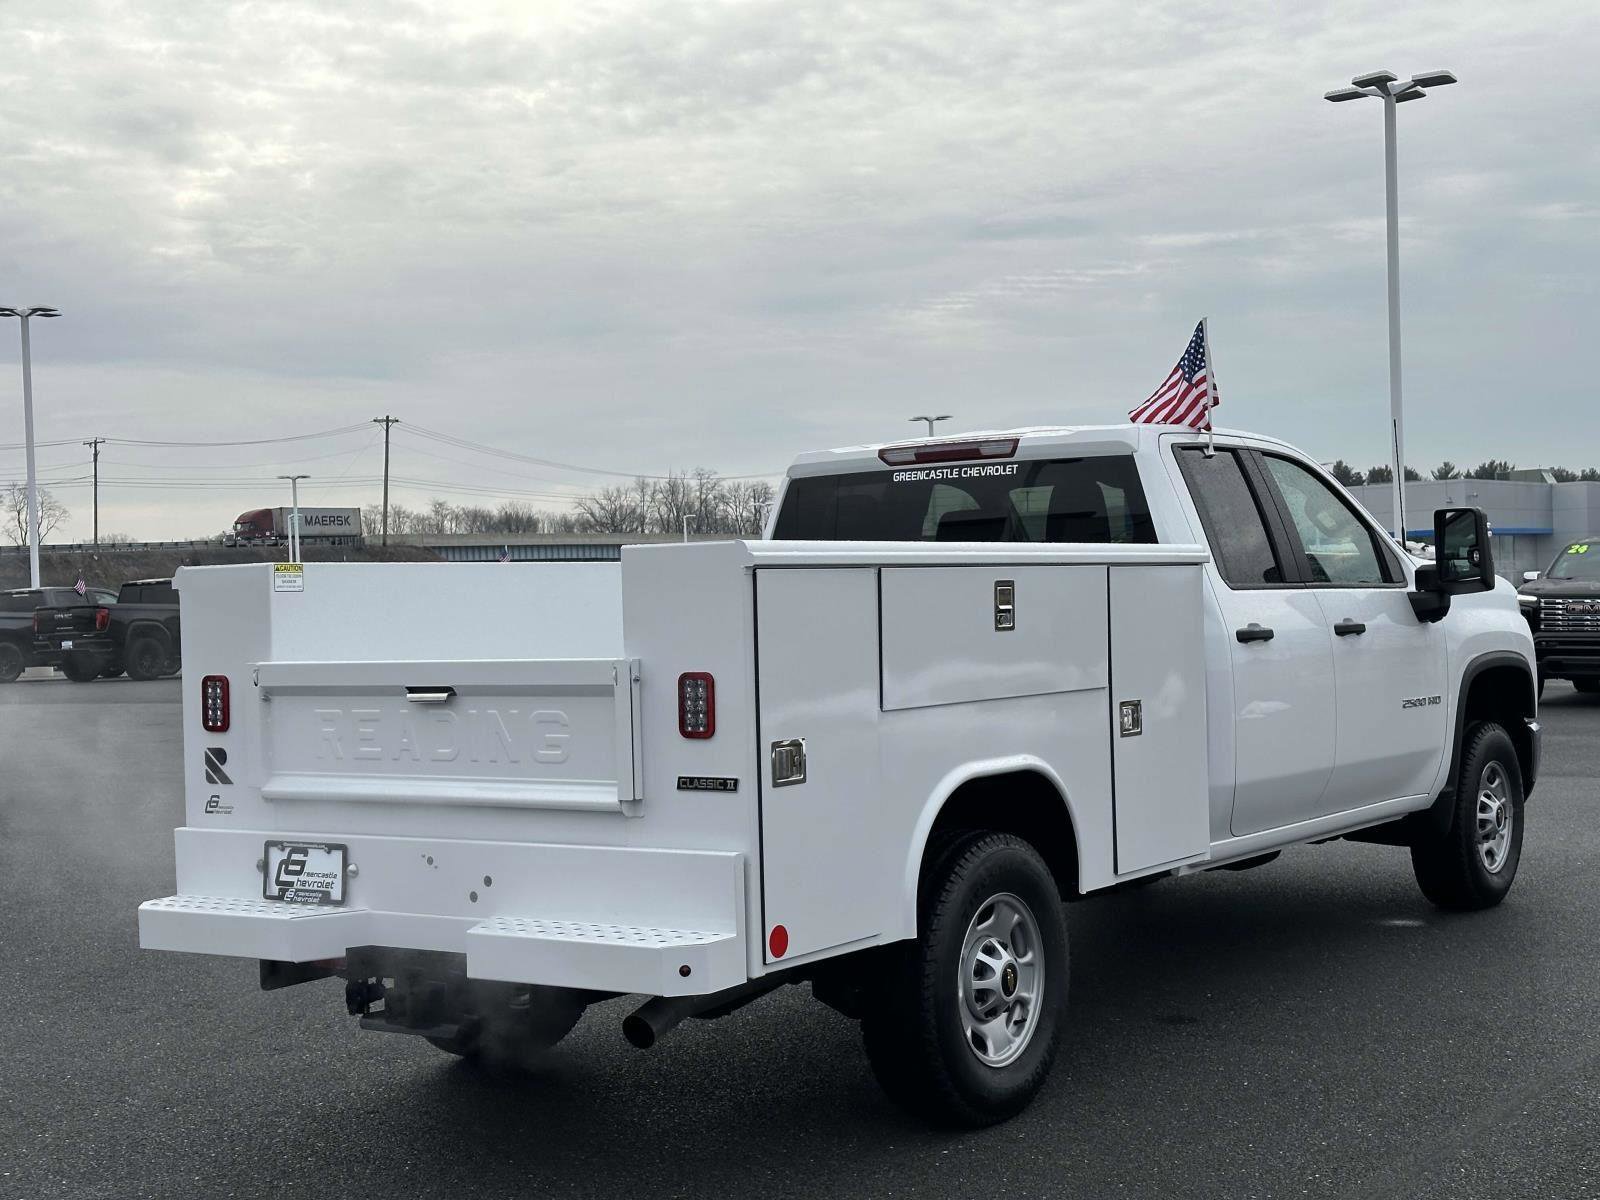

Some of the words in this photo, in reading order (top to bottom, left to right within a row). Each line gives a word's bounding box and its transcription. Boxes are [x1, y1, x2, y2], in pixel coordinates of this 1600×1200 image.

[893, 468, 959, 482] GREENCASTLE
[961, 464, 1019, 477] CHEVROLET
[304, 515, 351, 527] MAERSK
[1568, 604, 1600, 614] GM
[313, 709, 570, 764] READING
[679, 778, 724, 789] CLASSIC
[726, 779, 736, 789] II
